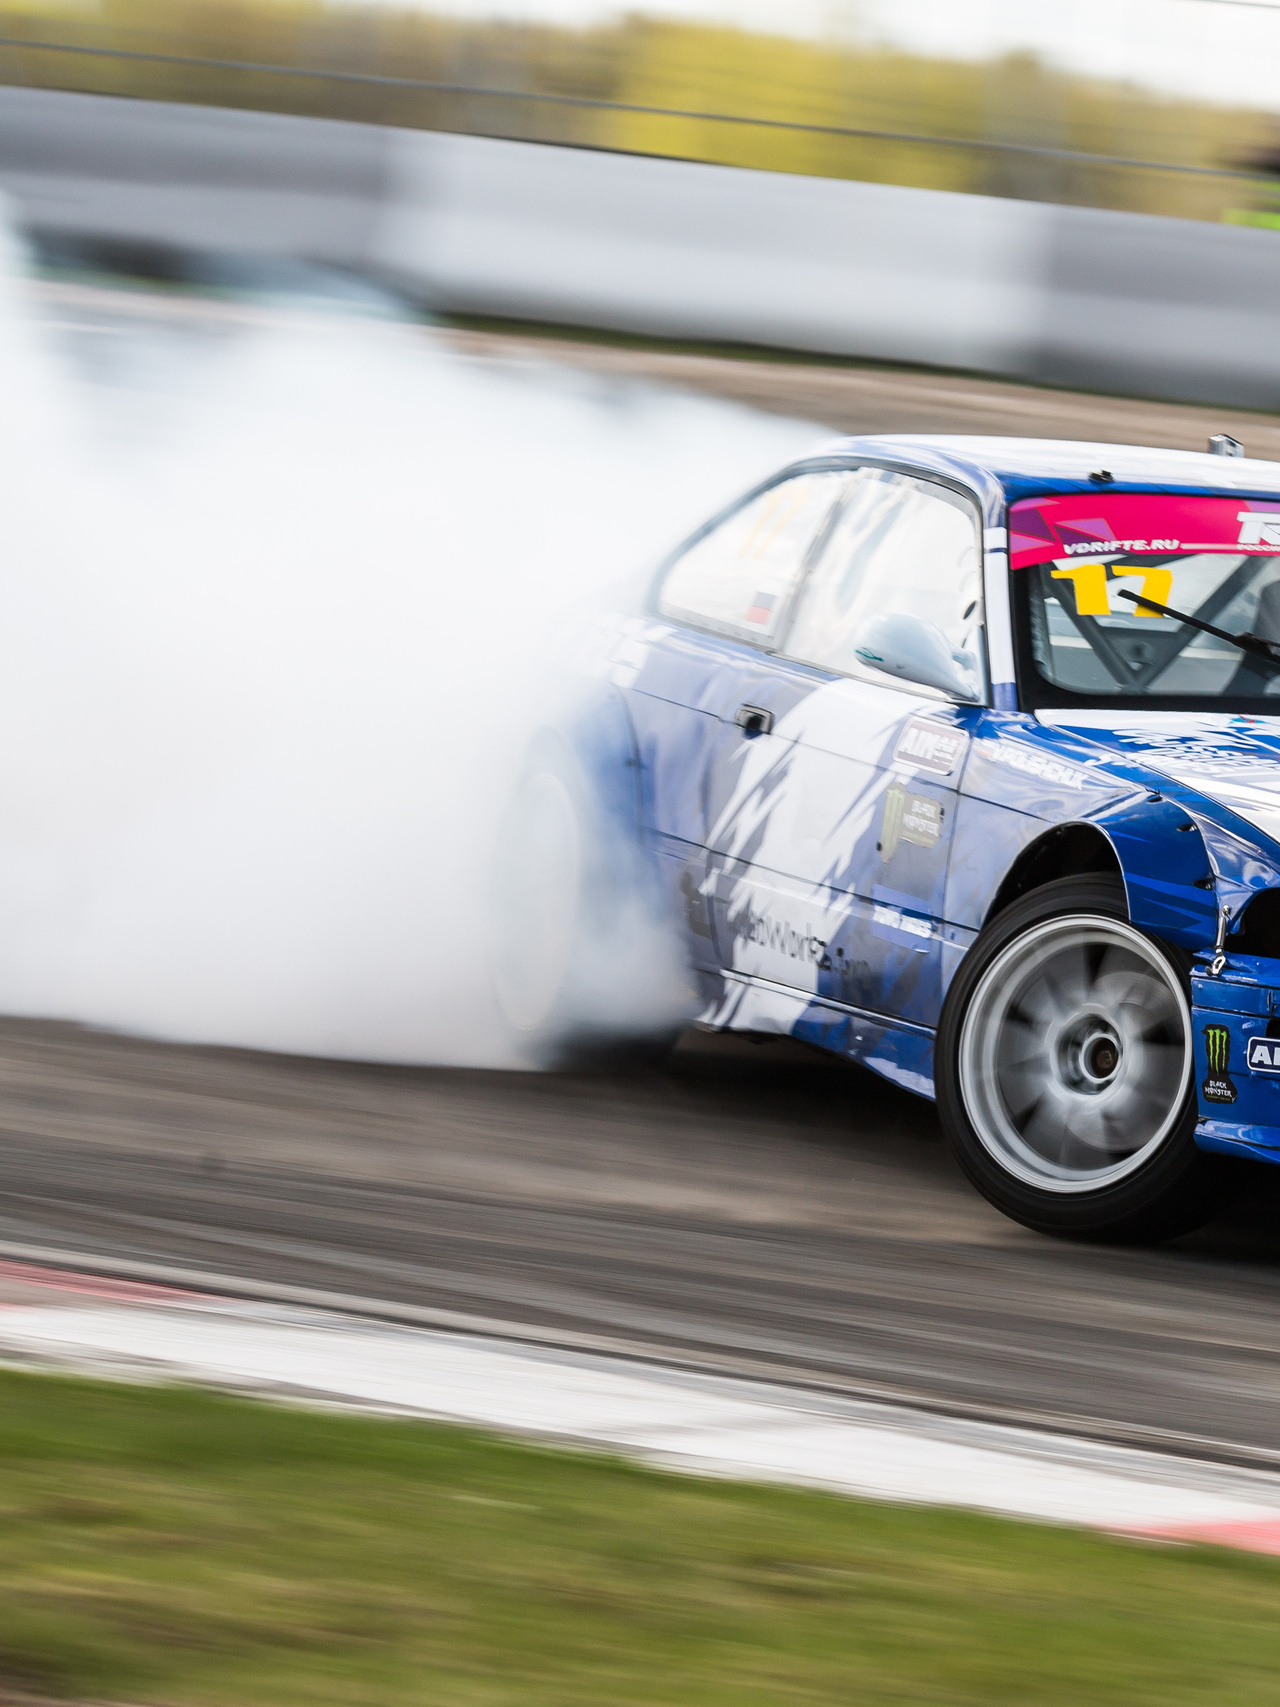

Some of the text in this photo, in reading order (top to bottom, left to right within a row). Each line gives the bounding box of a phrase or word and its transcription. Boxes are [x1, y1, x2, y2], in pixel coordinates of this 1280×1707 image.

[1050, 564, 1173, 618] 17
[1210, 1080, 1227, 1089] BLACK
[1205, 1087, 1232, 1098] MONSTER
